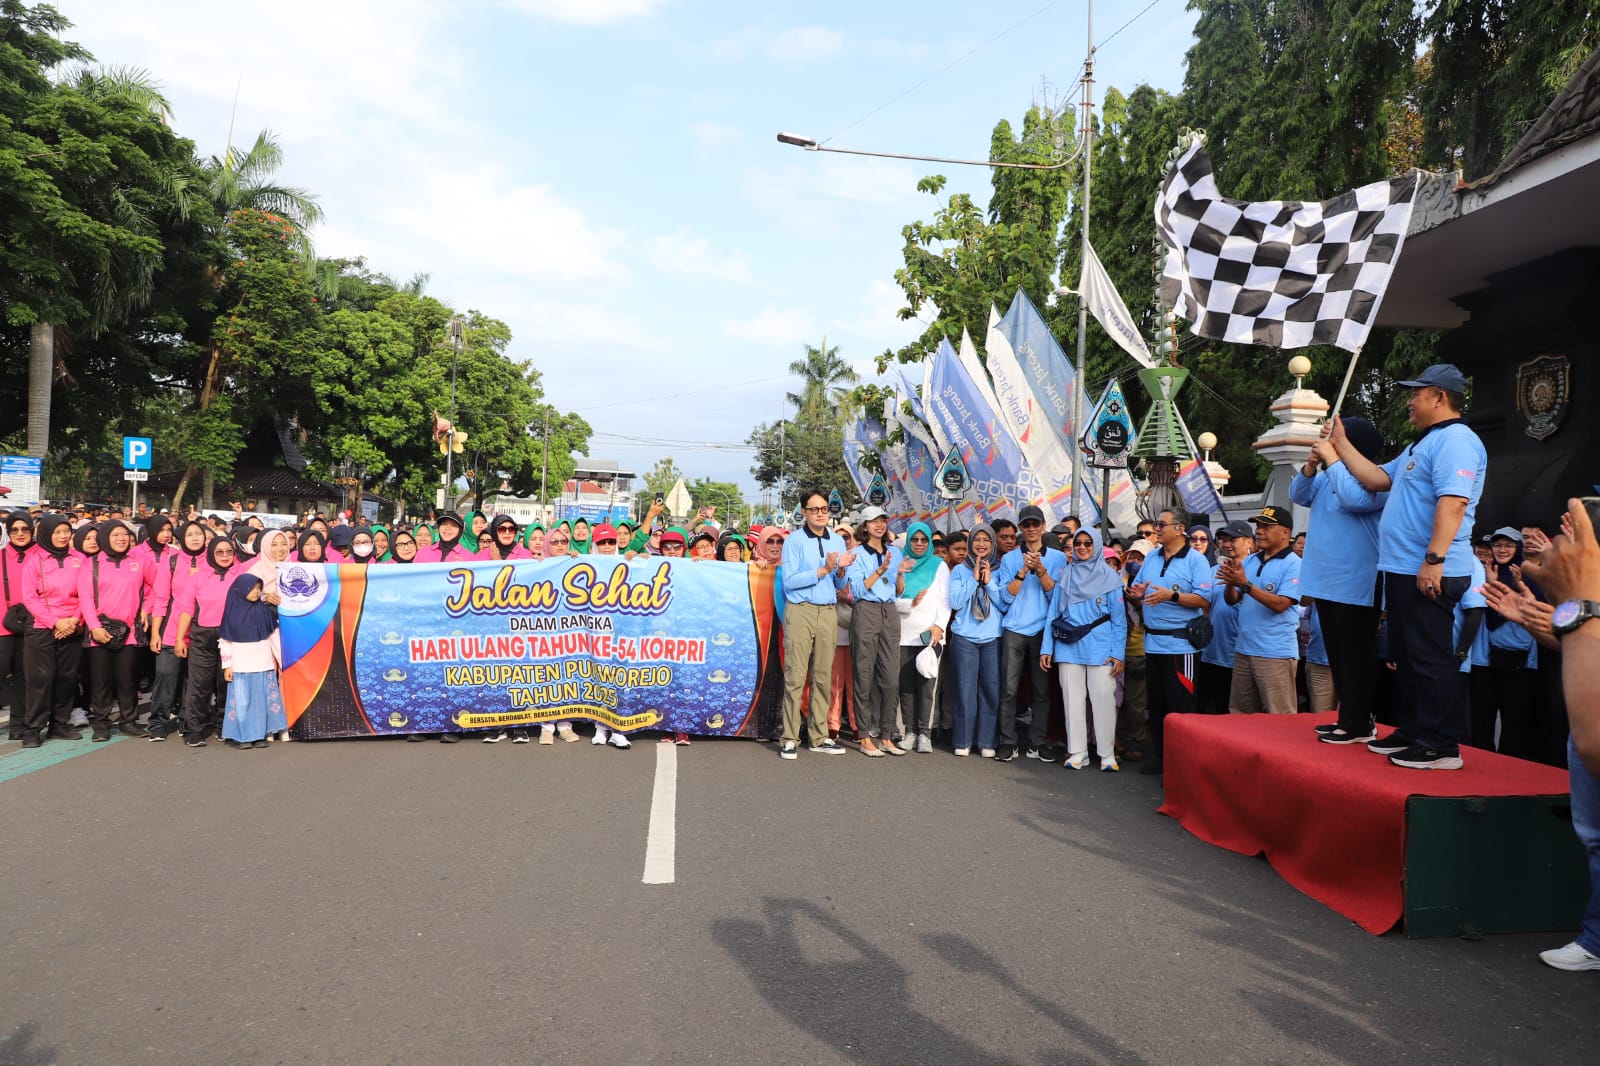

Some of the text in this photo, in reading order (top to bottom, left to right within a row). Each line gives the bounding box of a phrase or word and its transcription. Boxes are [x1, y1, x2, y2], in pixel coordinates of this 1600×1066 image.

[129, 440, 147, 465] P
[445, 561, 674, 617] Jalan Sehat
[510, 614, 613, 631] DALAM RANGKA
[411, 633, 705, 662] HARI ULANG TAHUN KE-54 KORPRI
[446, 662, 560, 686] KABUPATEN
[508, 681, 618, 708] TAHUN 2025
[562, 706, 584, 715] KORPRI
